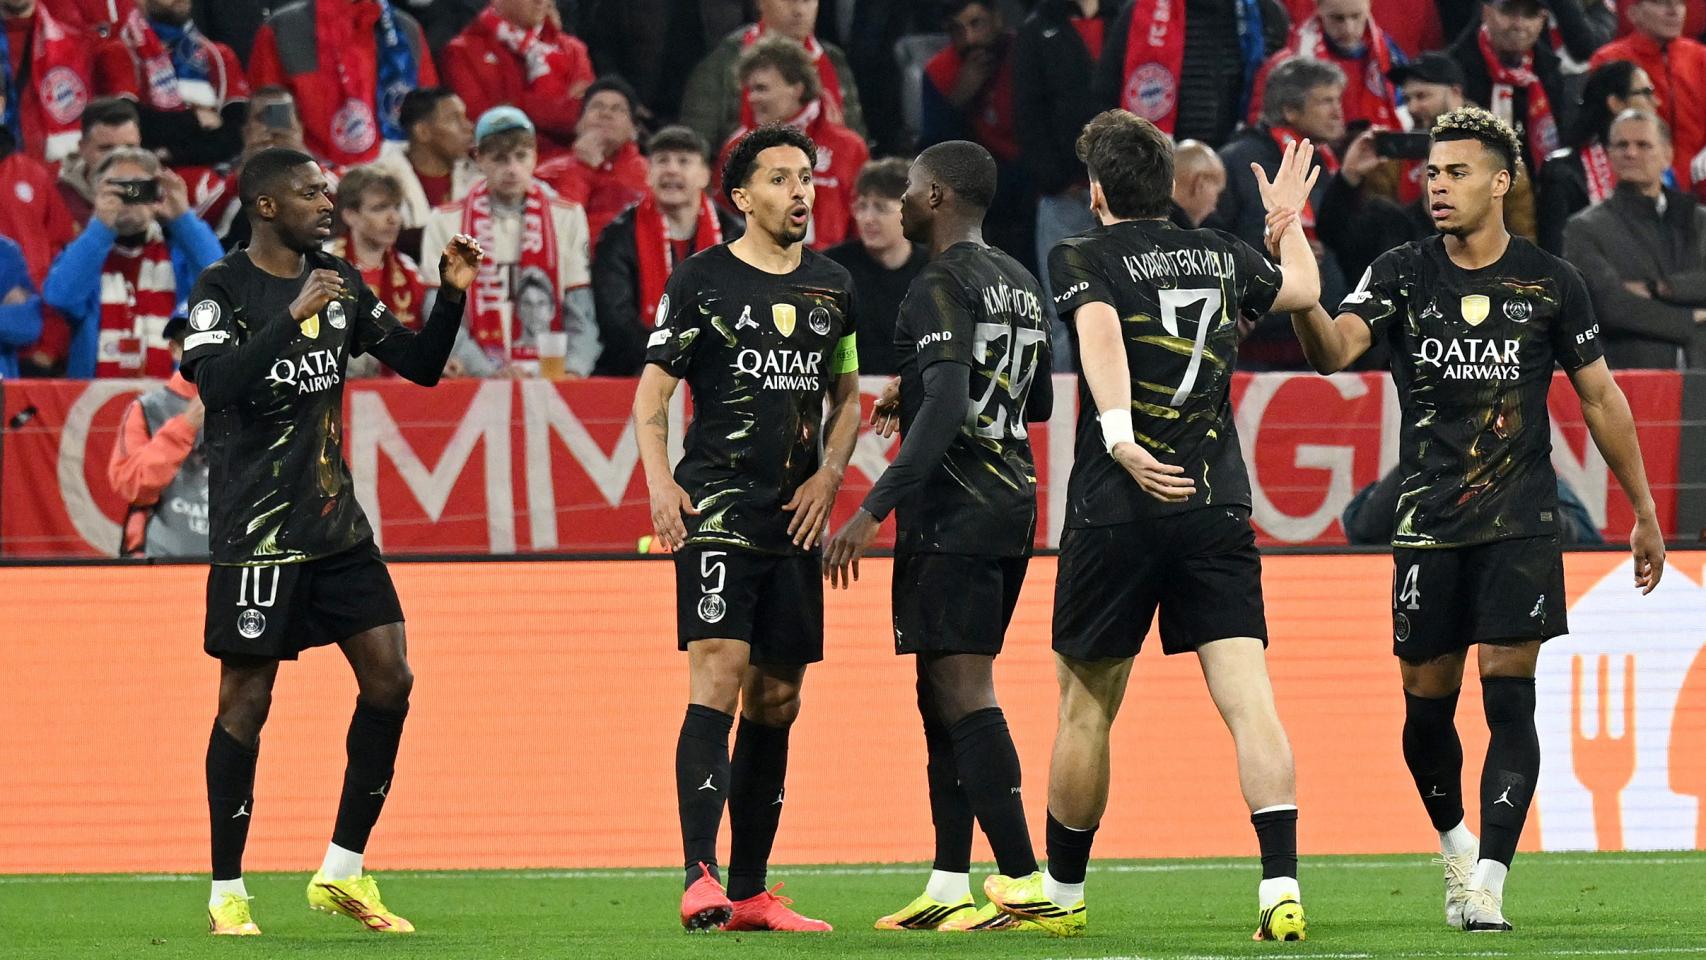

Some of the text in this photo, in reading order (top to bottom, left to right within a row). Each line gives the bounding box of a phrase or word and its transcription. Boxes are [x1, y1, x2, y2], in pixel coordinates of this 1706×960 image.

[1121, 247, 1237, 283] KVARATSKHELIA
[736, 349, 822, 378] QATAR
[1158, 288, 1221, 407] 7
[1420, 337, 1520, 368] QATAR
[762, 375, 819, 391] AIRWAYS
[1443, 364, 1520, 380] AIRWAYS
[236, 565, 280, 607] 10
[701, 551, 727, 594] 5
